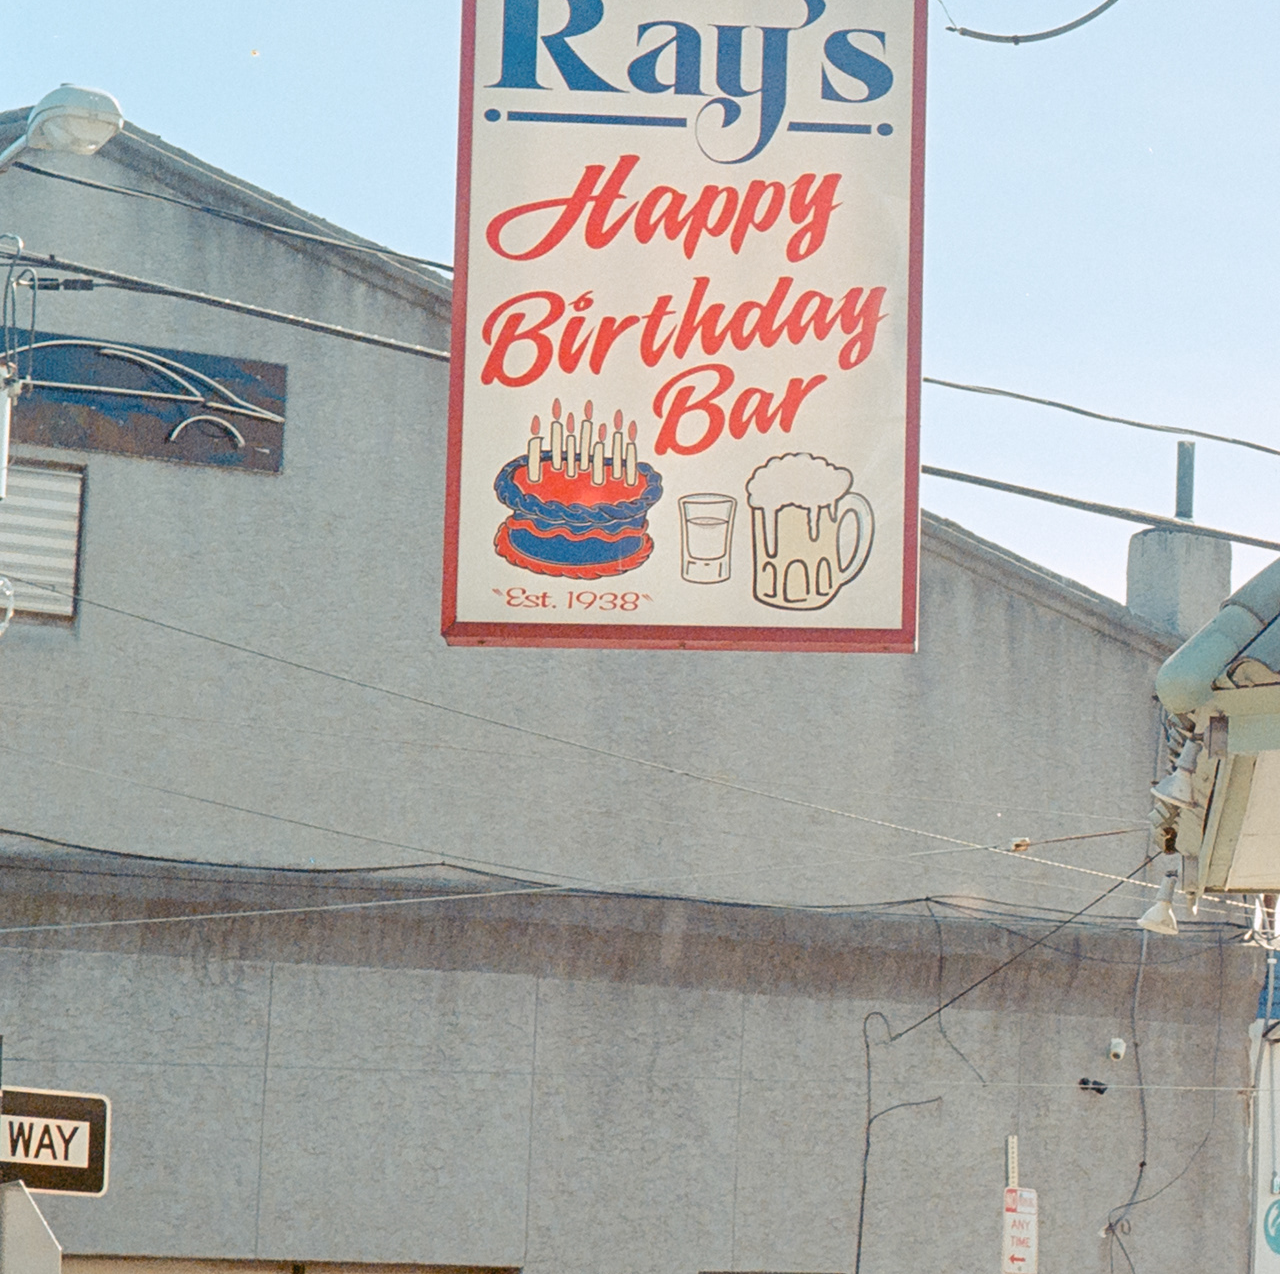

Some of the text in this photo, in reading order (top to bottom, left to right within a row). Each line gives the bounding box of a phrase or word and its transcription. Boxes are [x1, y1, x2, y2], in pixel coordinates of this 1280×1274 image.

[485, 154, 844, 263] Happy
[480, 276, 890, 388] Birthday
[652, 363, 828, 456] Bar
[8, 1120, 80, 1162] WAY
[1011, 1219, 1031, 1230] ANY
[1011, 1236, 1031, 1248] TIME
